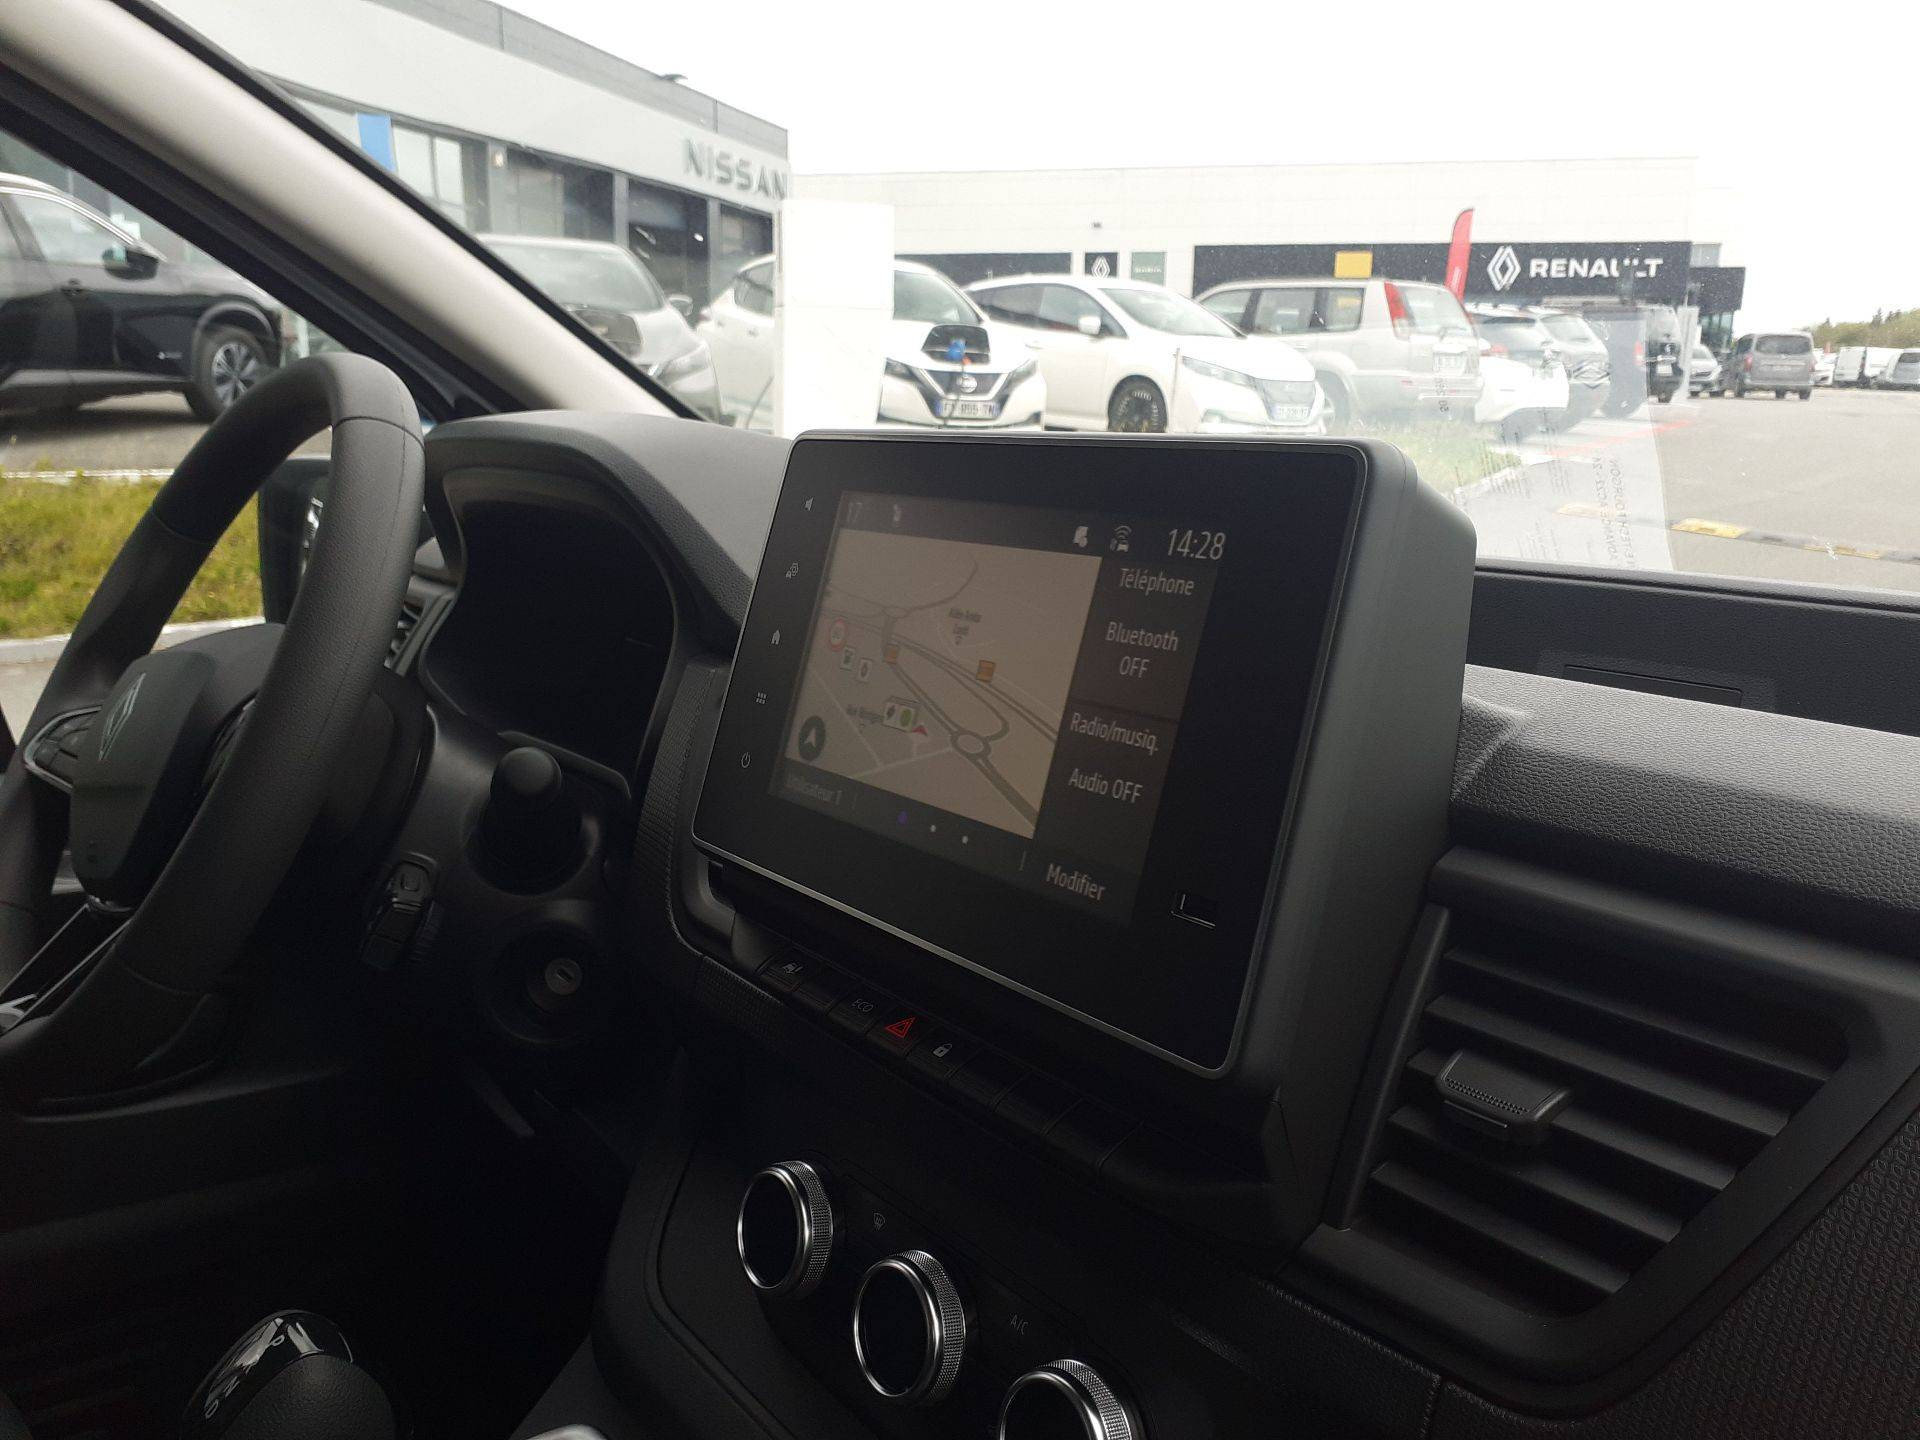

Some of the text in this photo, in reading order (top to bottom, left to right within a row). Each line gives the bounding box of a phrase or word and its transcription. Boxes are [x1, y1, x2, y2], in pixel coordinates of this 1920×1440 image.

[682, 138, 788, 201] NISSAN
[1167, 528, 1227, 560] 14:28
[1119, 567, 1195, 596] Téléphone
[1104, 621, 1179, 651] Bluetooth
[1118, 655, 1150, 679] OFF
[1069, 711, 1159, 756] Radio/musiq.
[1068, 767, 1144, 804] Audio OFF
[1046, 863, 1107, 901] Modifier
